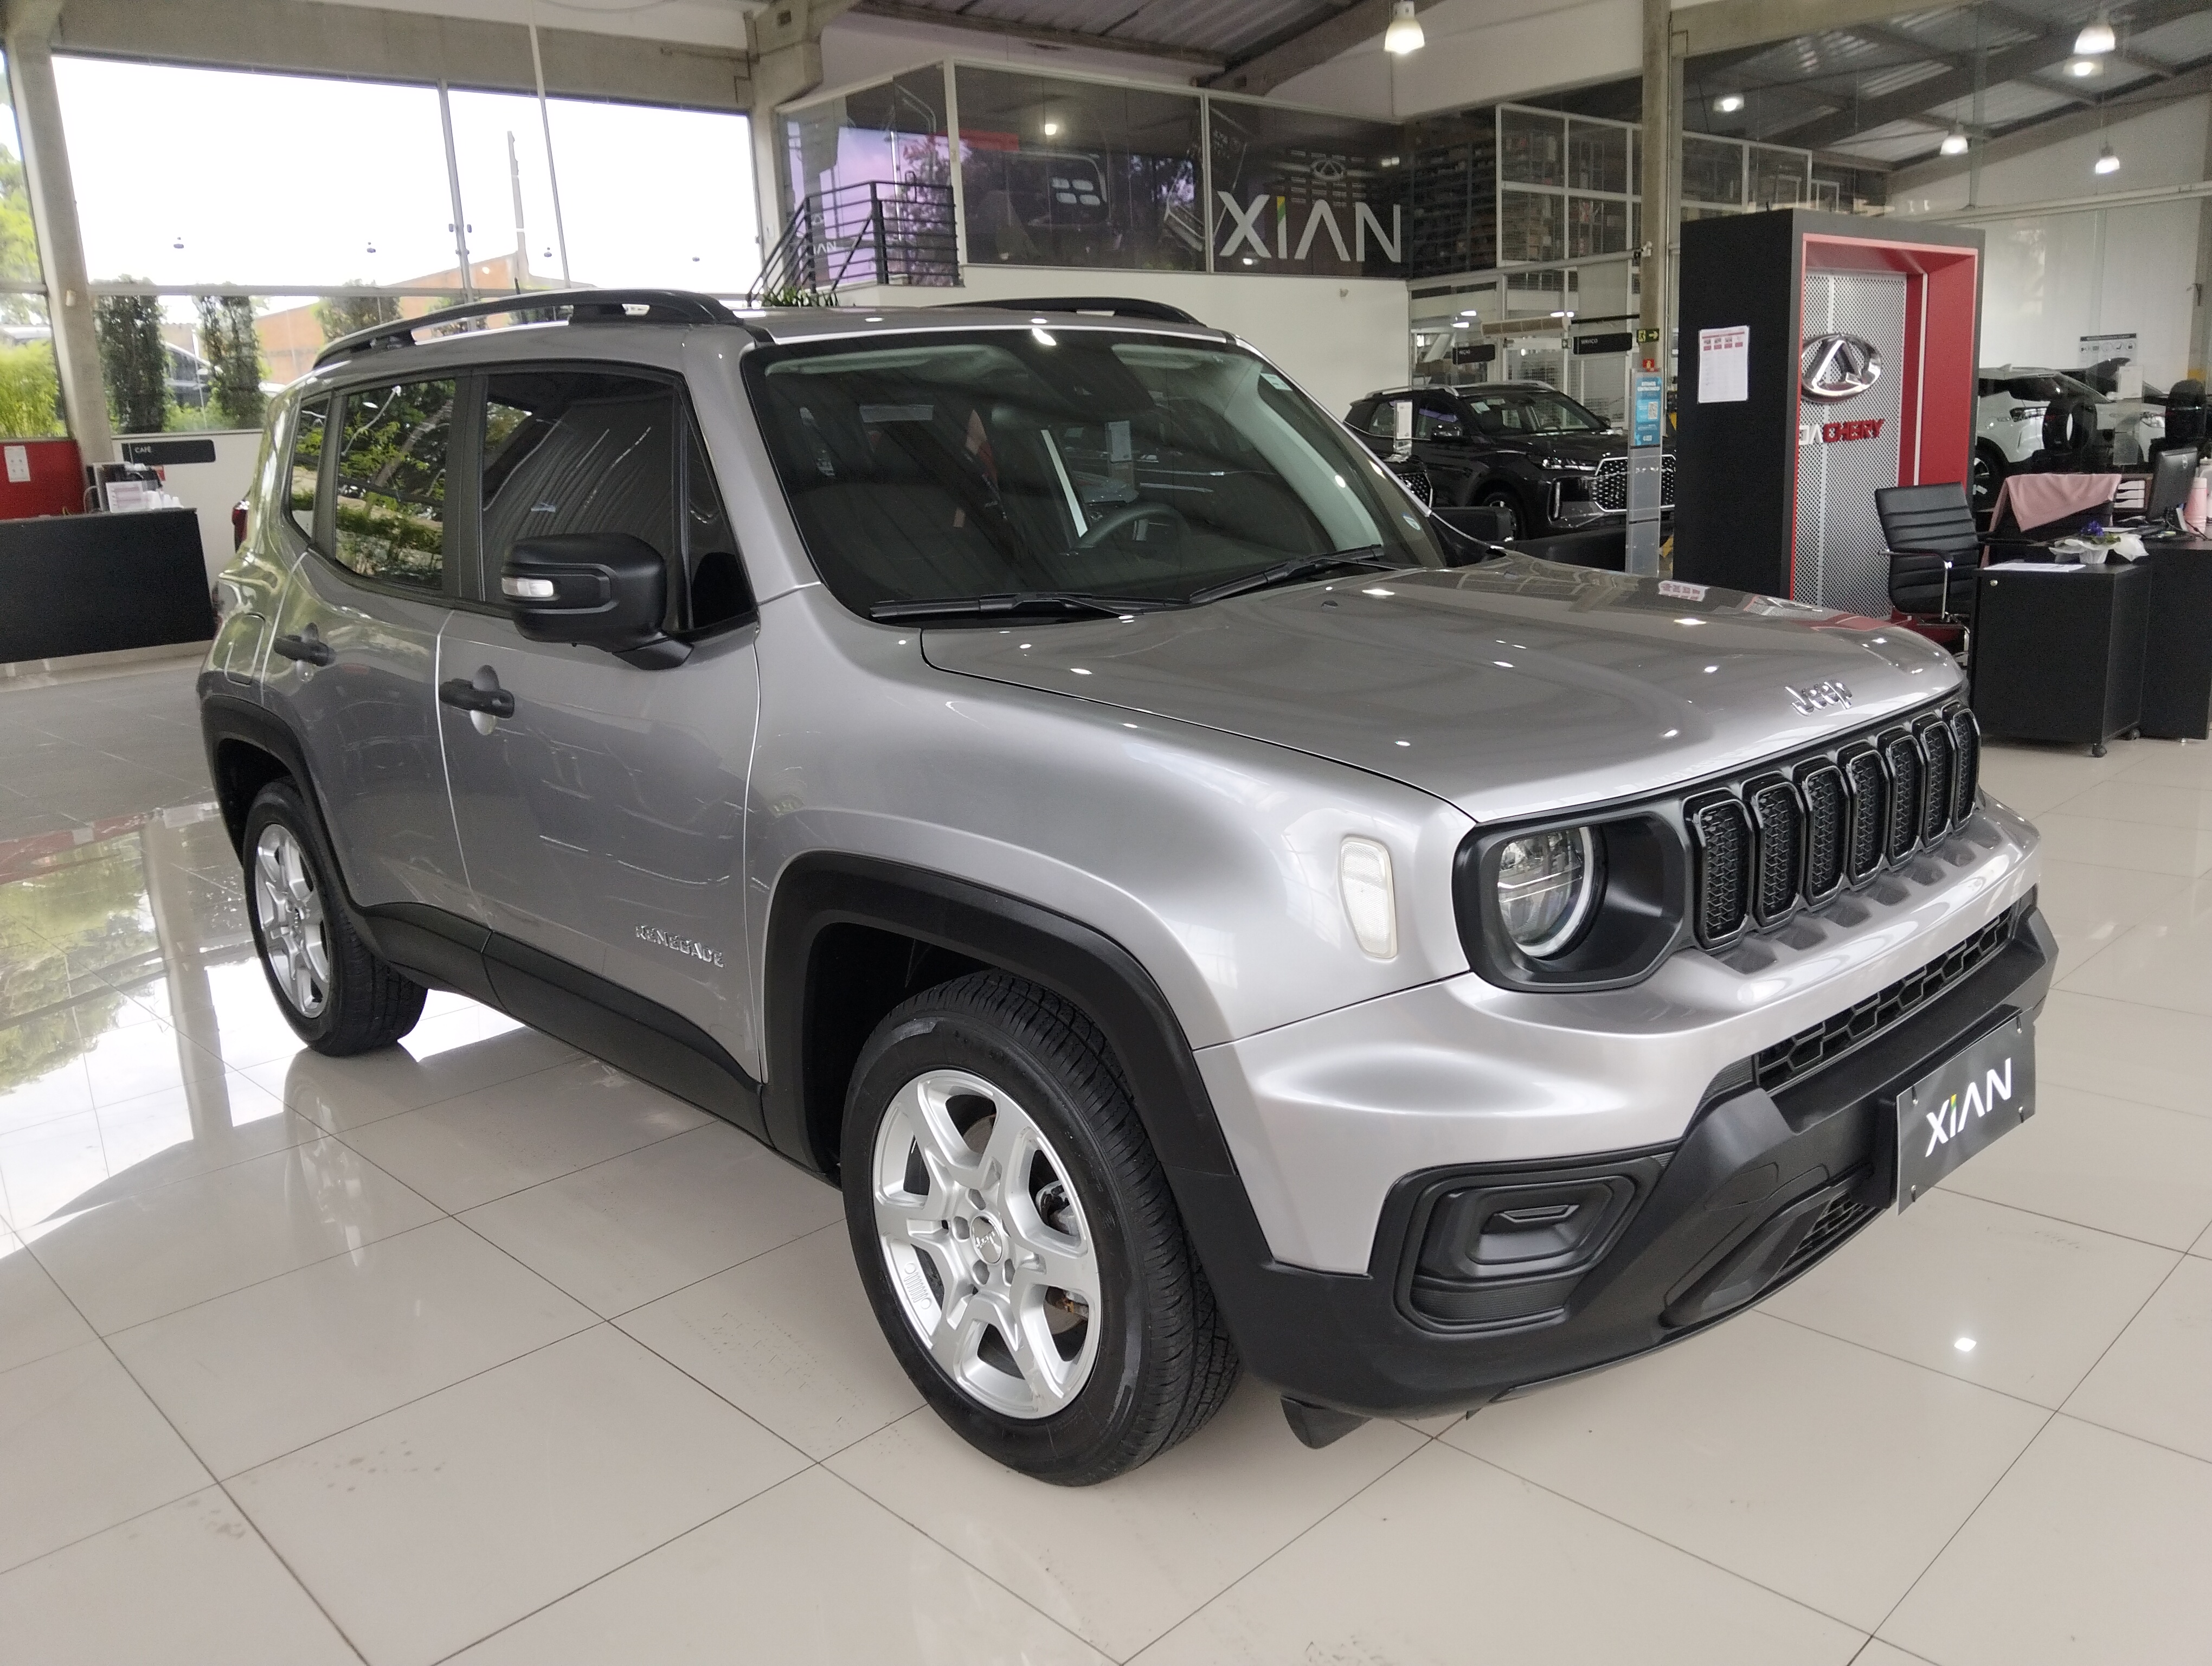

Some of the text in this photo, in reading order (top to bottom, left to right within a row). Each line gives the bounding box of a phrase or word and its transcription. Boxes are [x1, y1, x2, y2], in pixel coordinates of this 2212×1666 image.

[1217, 191, 1401, 263] XIAN
[1823, 418, 1885, 443] CHERY
[1784, 679, 1853, 716] Jeep
[635, 925, 724, 968] RENEGADE
[1925, 1057, 2012, 1157] XIAN
